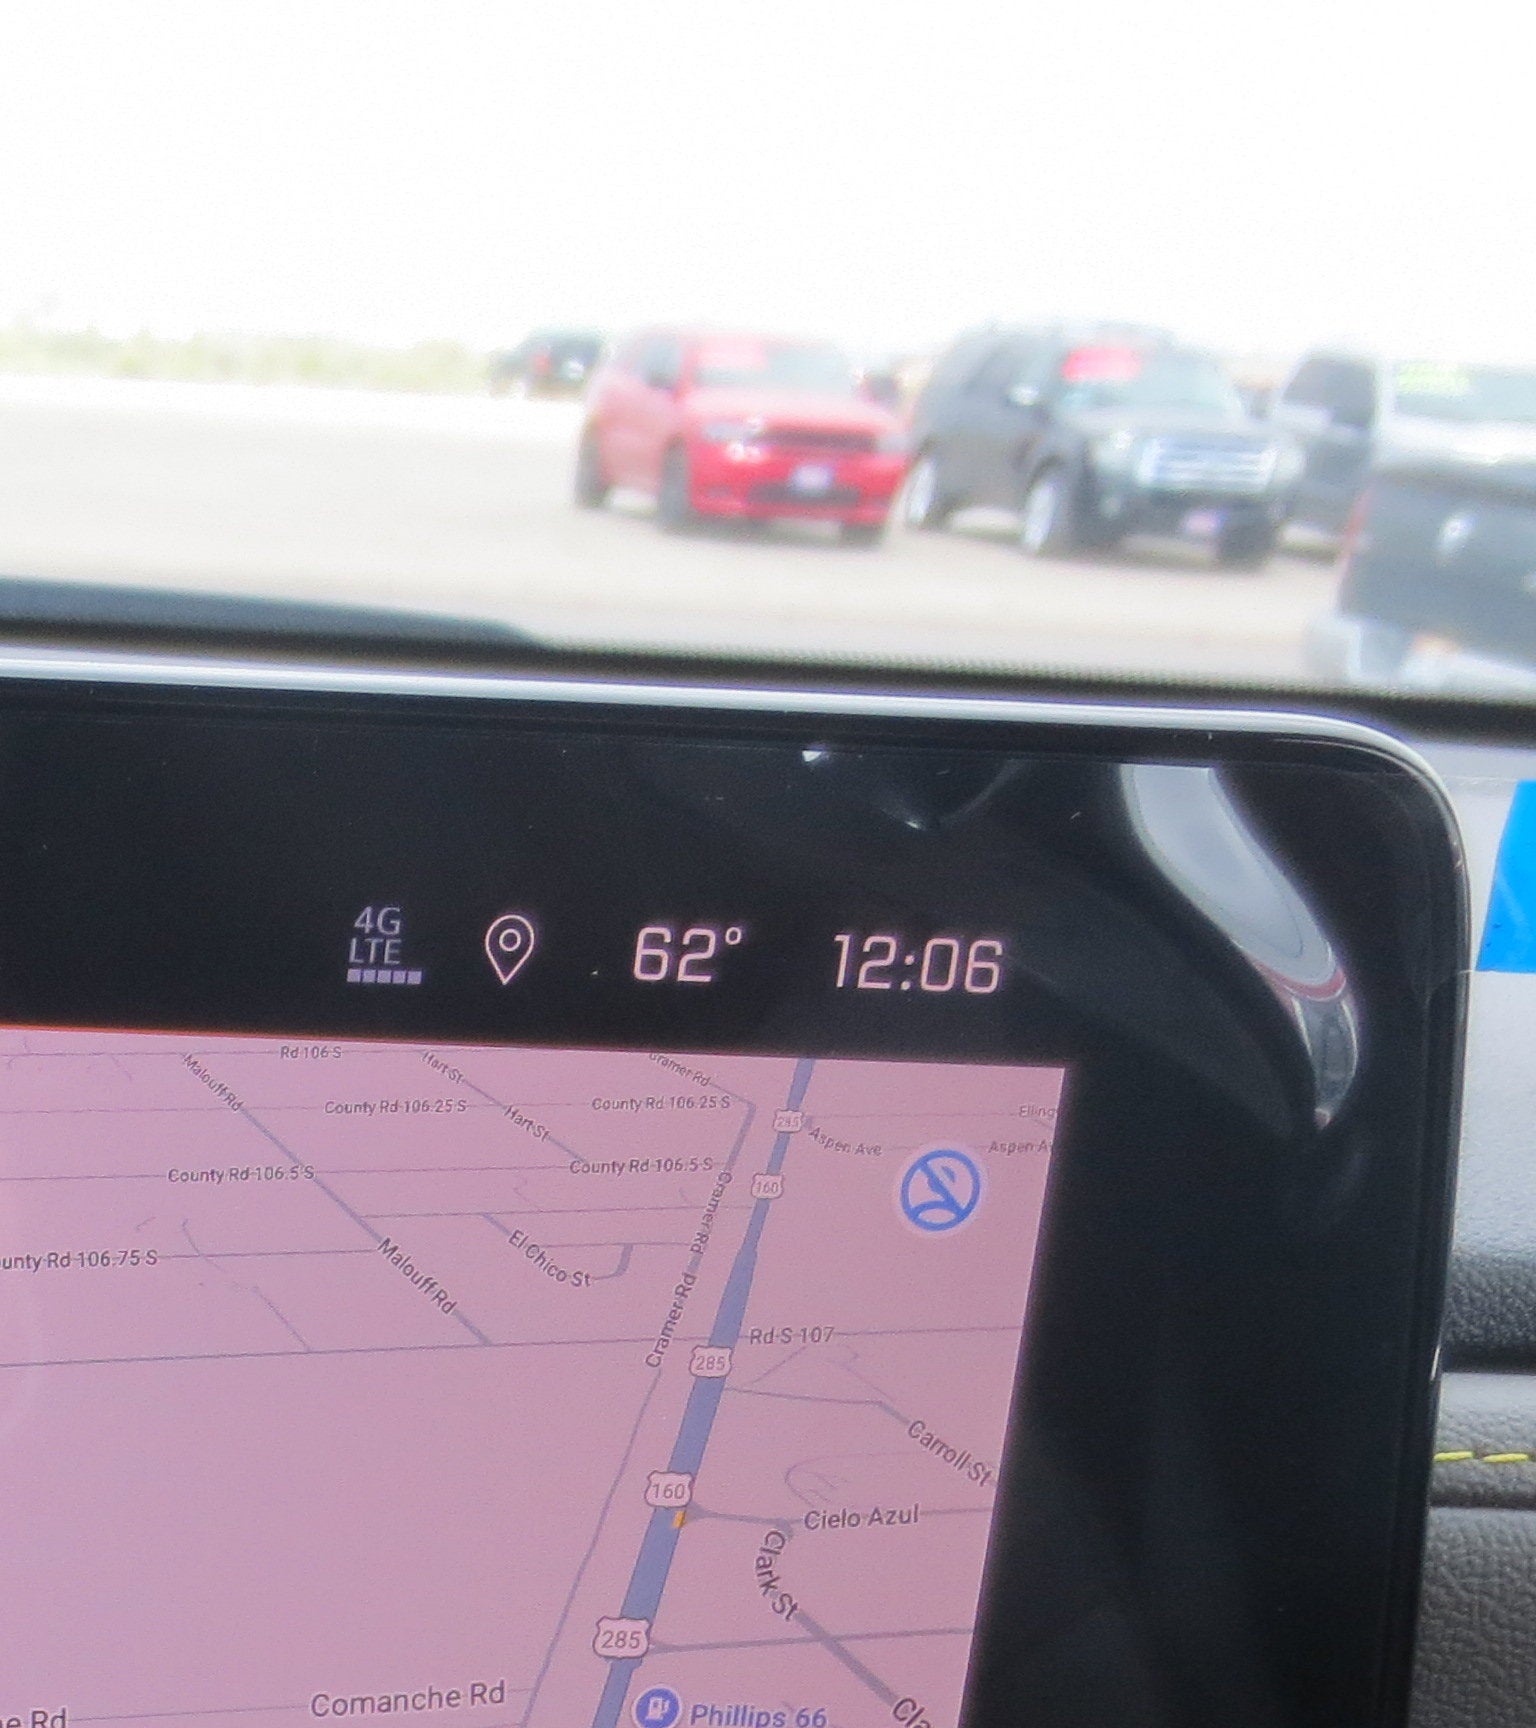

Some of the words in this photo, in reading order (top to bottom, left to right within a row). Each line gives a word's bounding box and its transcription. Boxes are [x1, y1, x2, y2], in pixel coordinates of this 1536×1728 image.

[353, 906, 402, 935] 4G
[348, 938, 402, 966] LTE
[632, 926, 743, 984] 62°
[833, 933, 1004, 995] 12:06
[280, 1045, 299, 1059] Rd
[303, 1045, 329, 1059] 106
[332, 1045, 343, 1059] S
[448, 1067, 464, 1084] St
[692, 1070, 712, 1087] Rd
[224, 1092, 244, 1112] Rd
[324, 1101, 376, 1116] County
[379, 1100, 399, 1114] Rd
[403, 1099, 454, 1113] 106.25
[457, 1099, 467, 1113] S
[591, 1097, 641, 1112] County
[645, 1096, 664, 1110] Rd
[670, 1096, 718, 1110] 106.25
[720, 1095, 731, 1109] S
[504, 1105, 534, 1132] Hart
[533, 1124, 551, 1143] St
[808, 1127, 851, 1152] Aspen
[854, 1144, 883, 1157] Ave
[167, 1168, 224, 1185] County
[228, 1167, 249, 1182] Rd
[255, 1166, 300, 1181] 106.5
[303, 1165, 315, 1180] S
[569, 1160, 625, 1175] County
[629, 1159, 650, 1173] Rd
[654, 1158, 699, 1172] 106.5
[702, 1157, 714, 1171] S
[756, 1181, 778, 1194] 160
[701, 1171, 732, 1230] Cramer
[690, 1232, 709, 1255] Rd
[46, 1252, 71, 1269] Rd
[76, 1250, 141, 1268] 106.75
[145, 1249, 159, 1266] S
[508, 1229, 529, 1250] El
[524, 1243, 568, 1283] Chico
[571, 1269, 592, 1288] St
[377, 1237, 438, 1295] Malouff
[431, 1288, 458, 1315] Rd
[645, 1302, 685, 1368] Cramer
[675, 1272, 697, 1299] Rd
[749, 1327, 775, 1345] Rd
[780, 1327, 794, 1344] S
[799, 1326, 836, 1344] 107
[695, 1355, 726, 1371] 285
[907, 1419, 971, 1471] Carroll
[966, 1460, 992, 1488] St
[651, 1482, 686, 1500] 160
[803, 1510, 861, 1531] Cielo
[867, 1503, 920, 1526] Azul
[755, 1530, 787, 1597] Clark
[771, 1591, 799, 1621] St
[601, 1630, 642, 1650] 285
[309, 1686, 463, 1719] Comanche
[470, 1680, 506, 1707] Rd
[794, 1706, 828, 1728] 66
